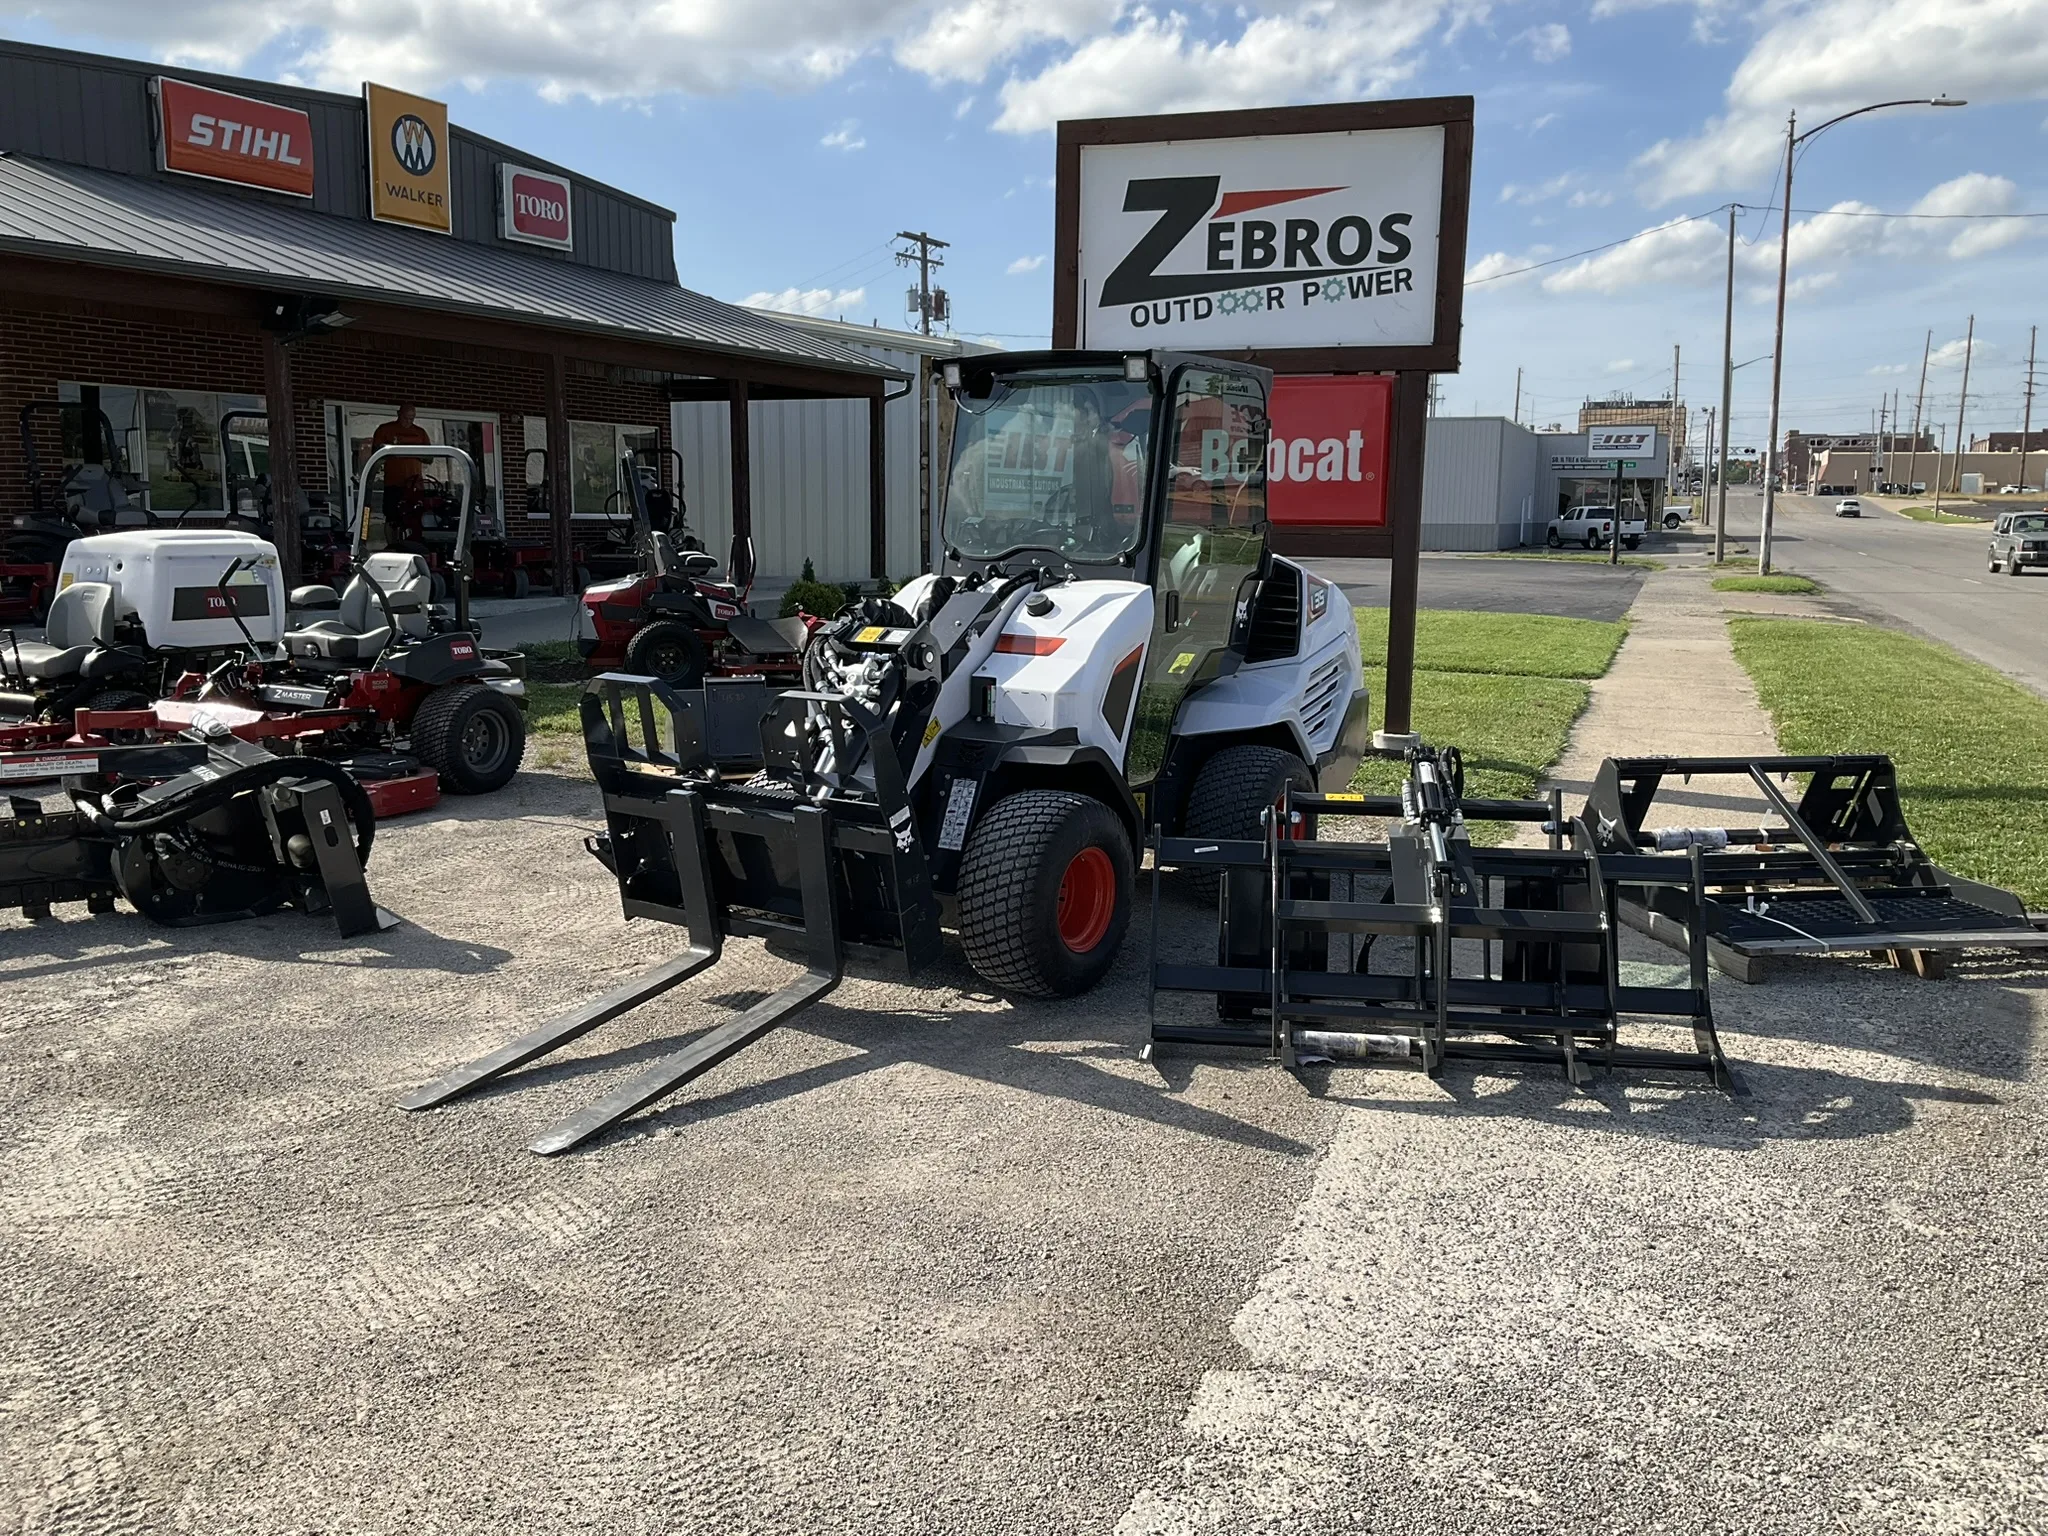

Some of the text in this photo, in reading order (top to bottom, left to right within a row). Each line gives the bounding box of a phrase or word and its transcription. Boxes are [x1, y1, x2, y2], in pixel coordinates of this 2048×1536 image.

[188, 113, 301, 166] STIHL
[386, 182, 443, 208] WALKER
[516, 193, 564, 222] TORO
[1099, 175, 1412, 308] ZEBROS
[1303, 268, 1412, 308] POWER
[1603, 435, 1650, 444] IBT
[1201, 429, 1364, 482] Bobcat
[717, 608, 734, 616] TORO
[452, 647, 473, 655] TORO
[274, 689, 312, 700] Z MASTER
